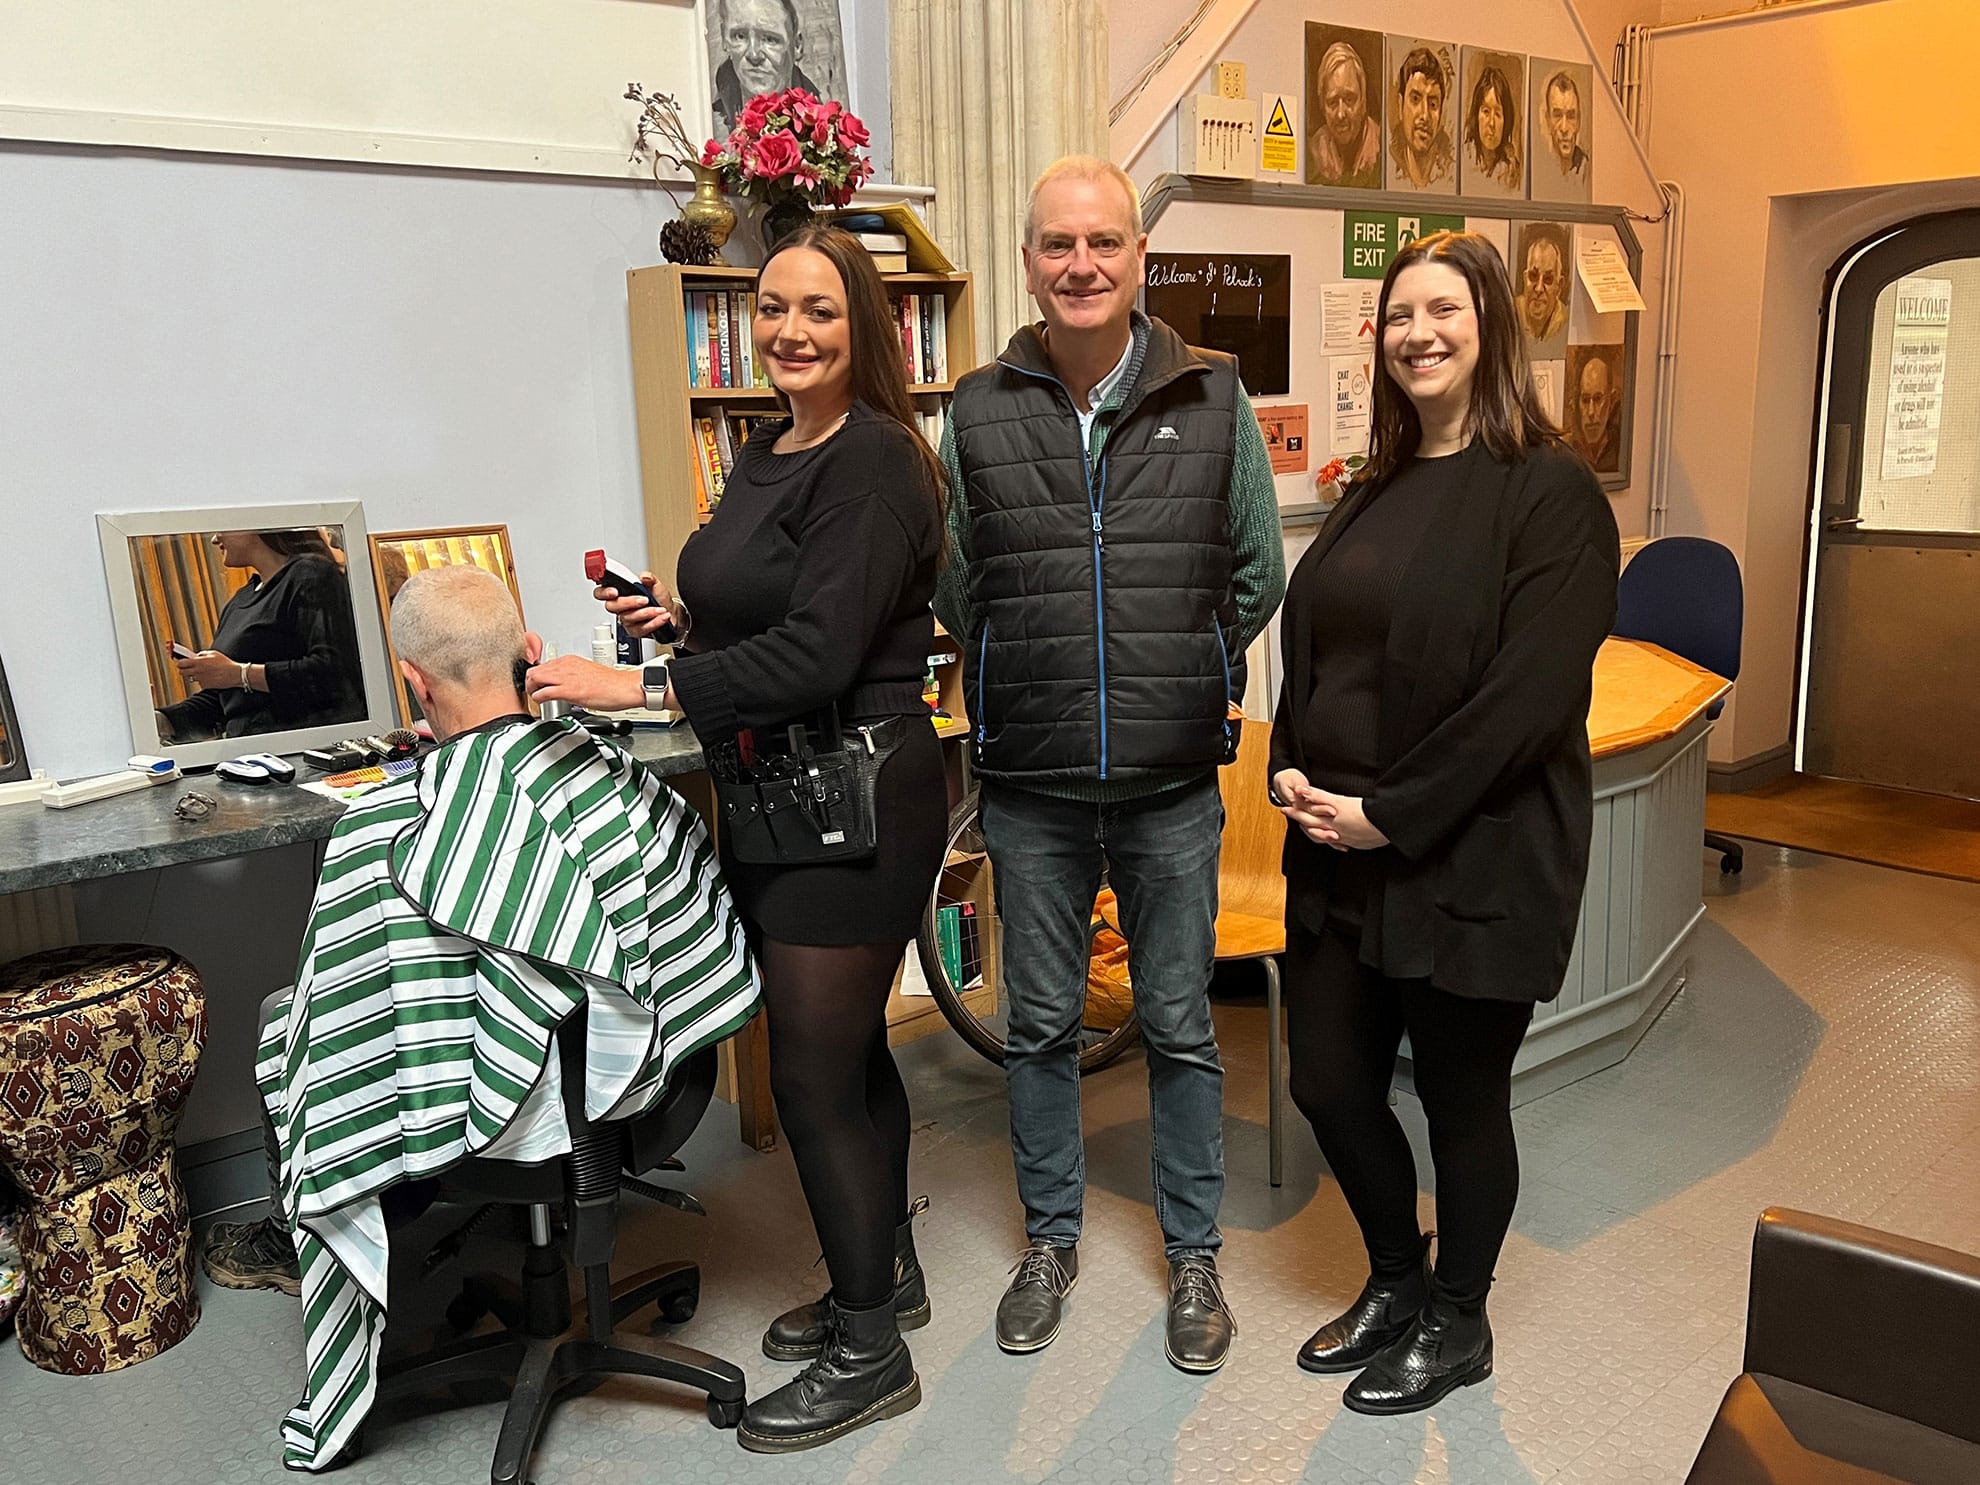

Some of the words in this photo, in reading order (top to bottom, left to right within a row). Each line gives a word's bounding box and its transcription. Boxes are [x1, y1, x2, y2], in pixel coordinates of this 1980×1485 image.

[1353, 222, 1386, 242] FIRE
[1353, 247, 1386, 267] EXIT
[1148, 262, 1198, 287] Welcome
[1899, 297, 1949, 321] WELCOME
[717, 297, 731, 374] MOONDUST
[1337, 370, 1349, 381] CHAT
[1337, 392, 1349, 401] MAKE
[1337, 401, 1354, 412] CHANGE
